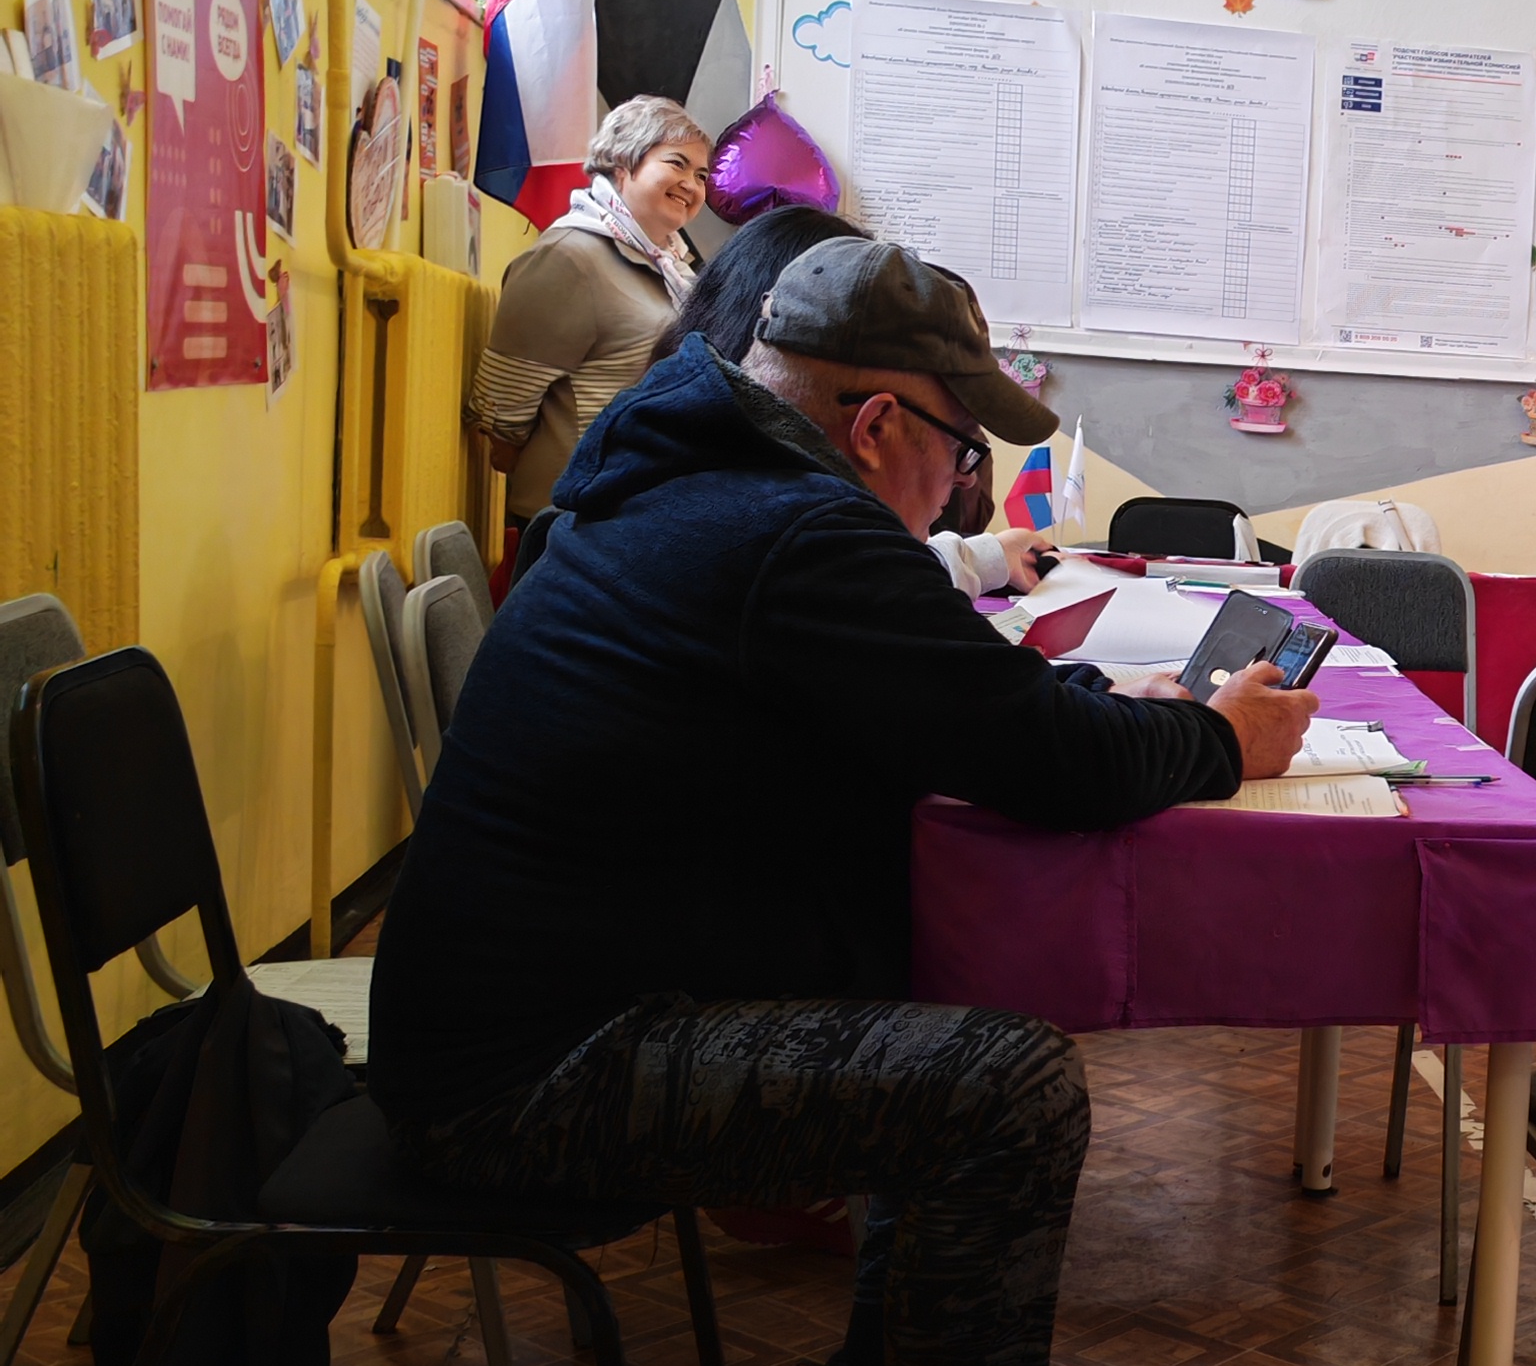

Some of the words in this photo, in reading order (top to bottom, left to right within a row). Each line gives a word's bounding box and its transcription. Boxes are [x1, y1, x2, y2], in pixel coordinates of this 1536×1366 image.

[158, 0, 193, 34] ПОМОГАЙ
[217, 3, 240, 31] РЯДОМ
[217, 34, 241, 61] ВСЕГДА
